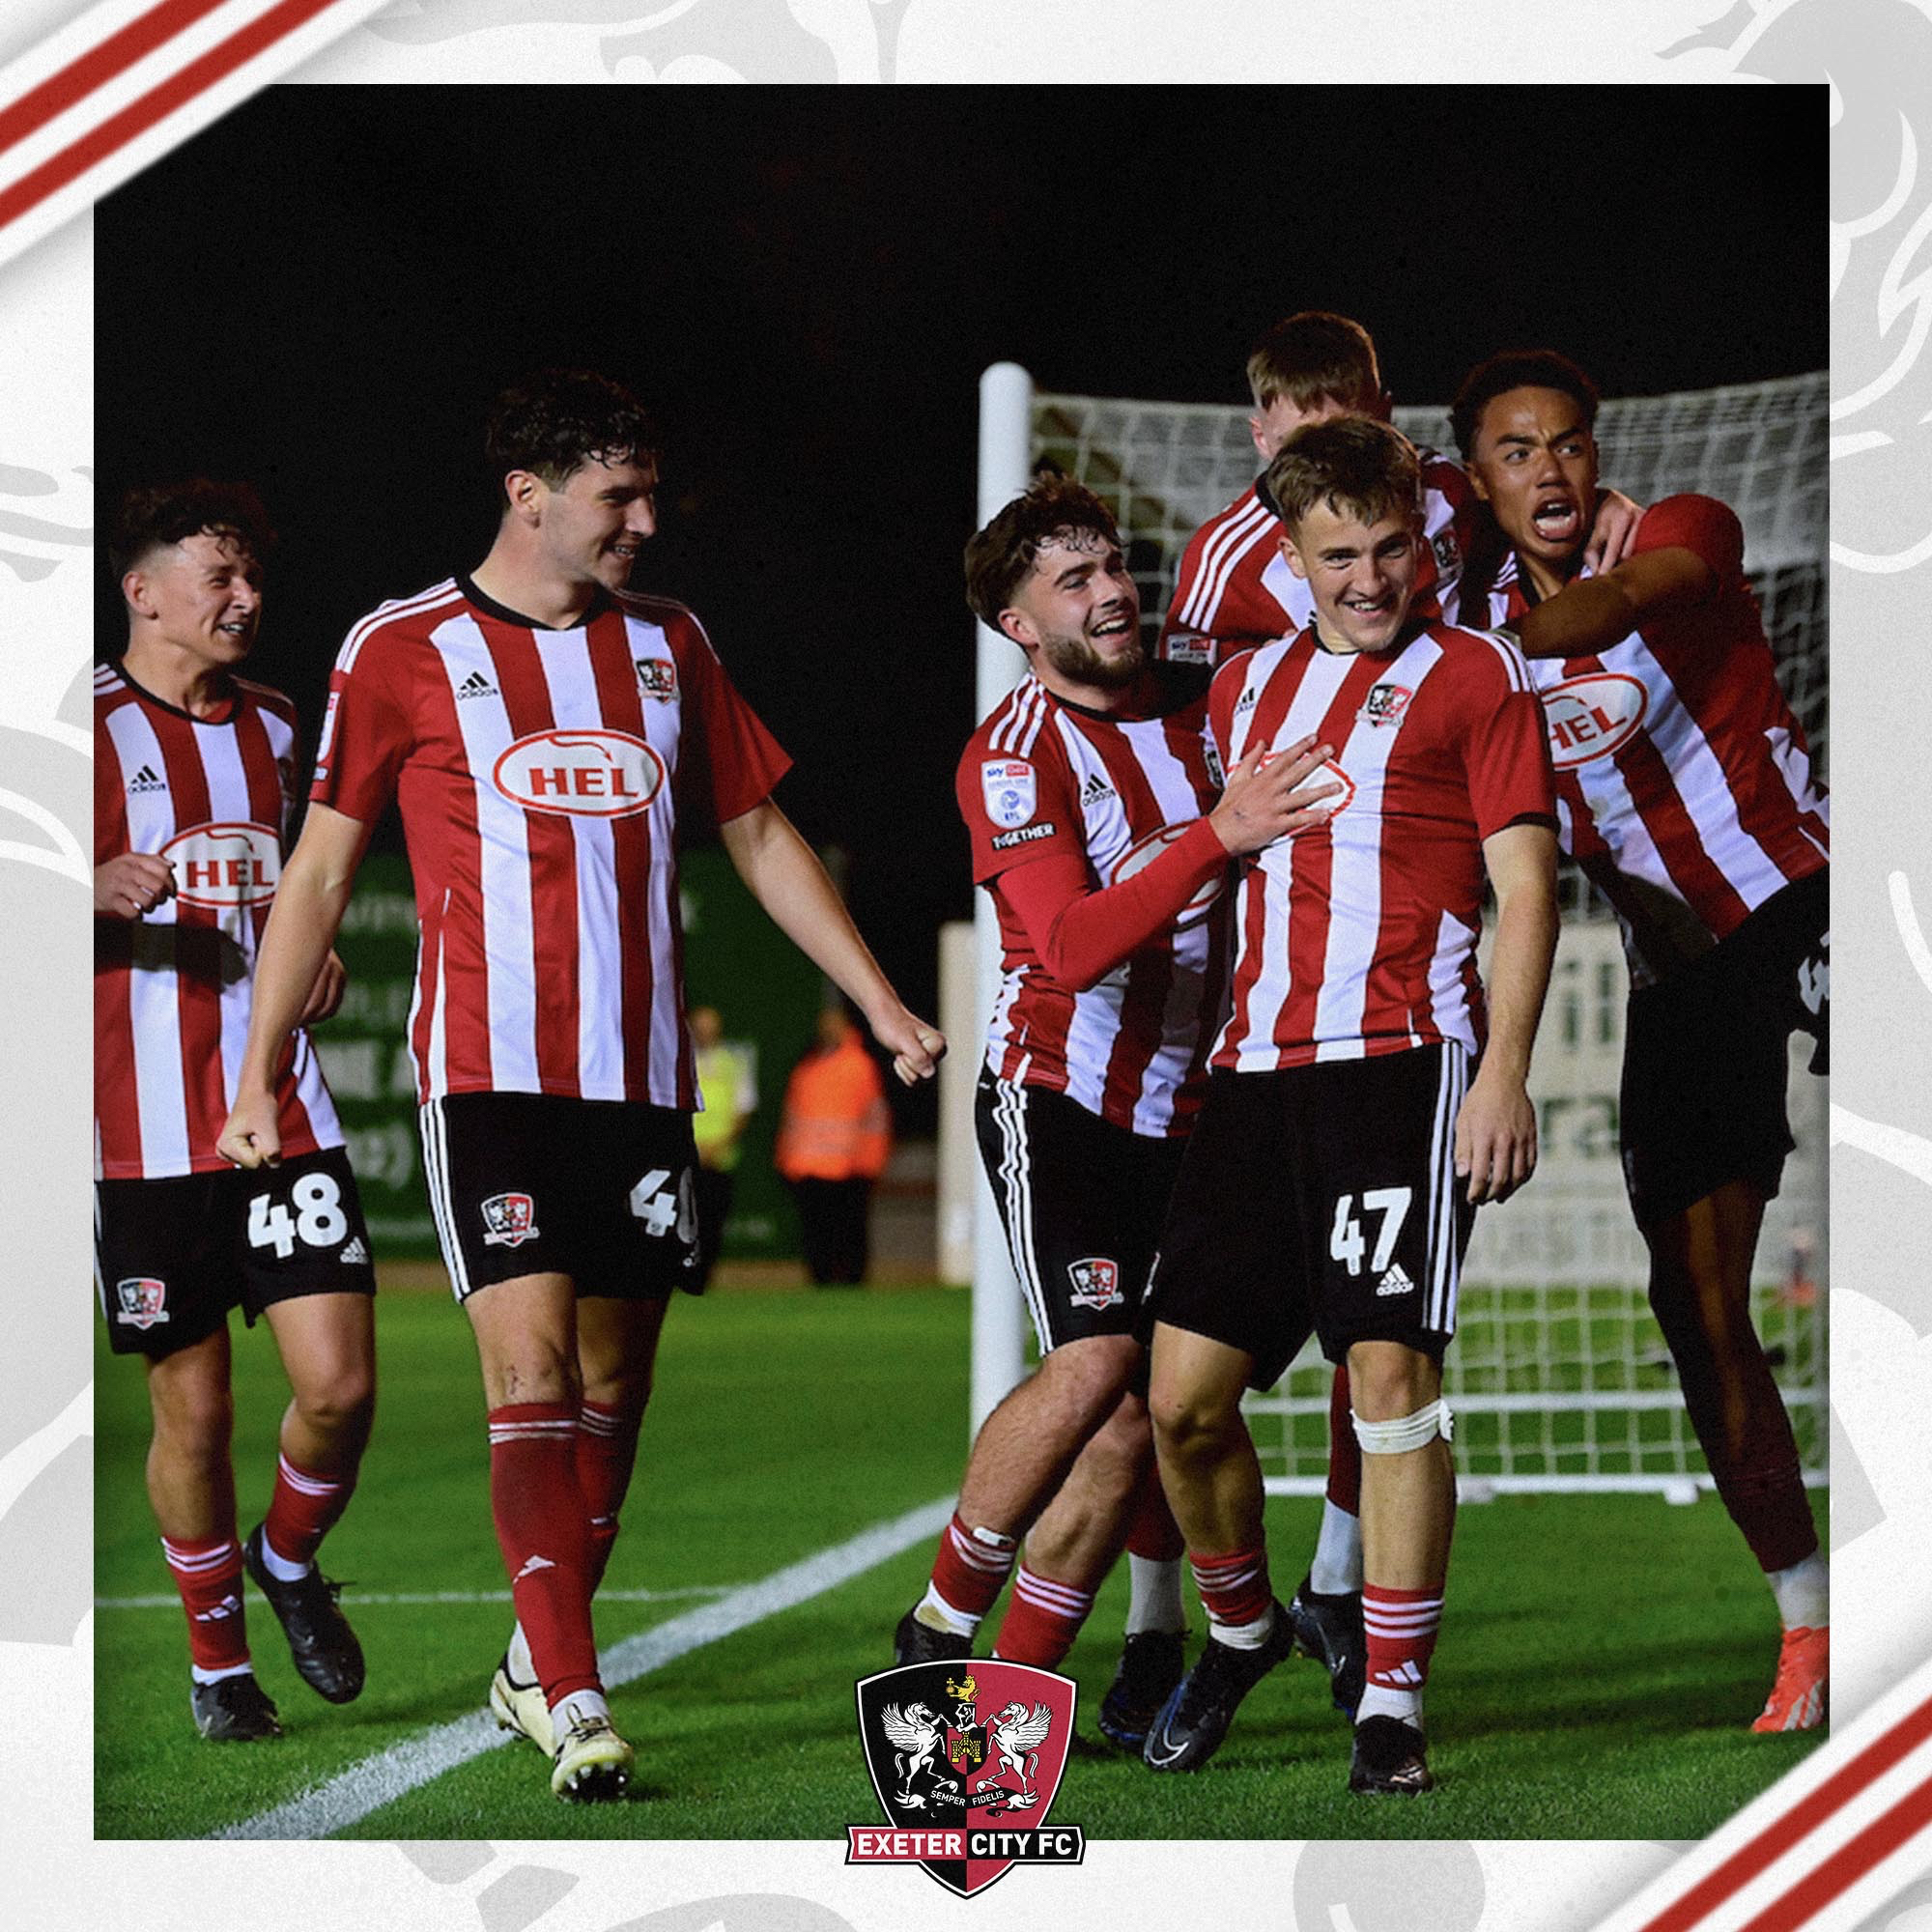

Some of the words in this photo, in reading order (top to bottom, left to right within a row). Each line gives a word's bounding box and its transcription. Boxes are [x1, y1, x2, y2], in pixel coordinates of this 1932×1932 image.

[456, 689, 498, 700] adidas
[127, 782, 166, 795] adidas
[528, 767, 639, 798] HEL
[1083, 788, 1117, 808] adidas
[991, 823, 1055, 850] TOGETHER
[185, 859, 275, 889] HEL
[247, 1172, 348, 1259] 48
[1330, 1186, 1412, 1276] 47
